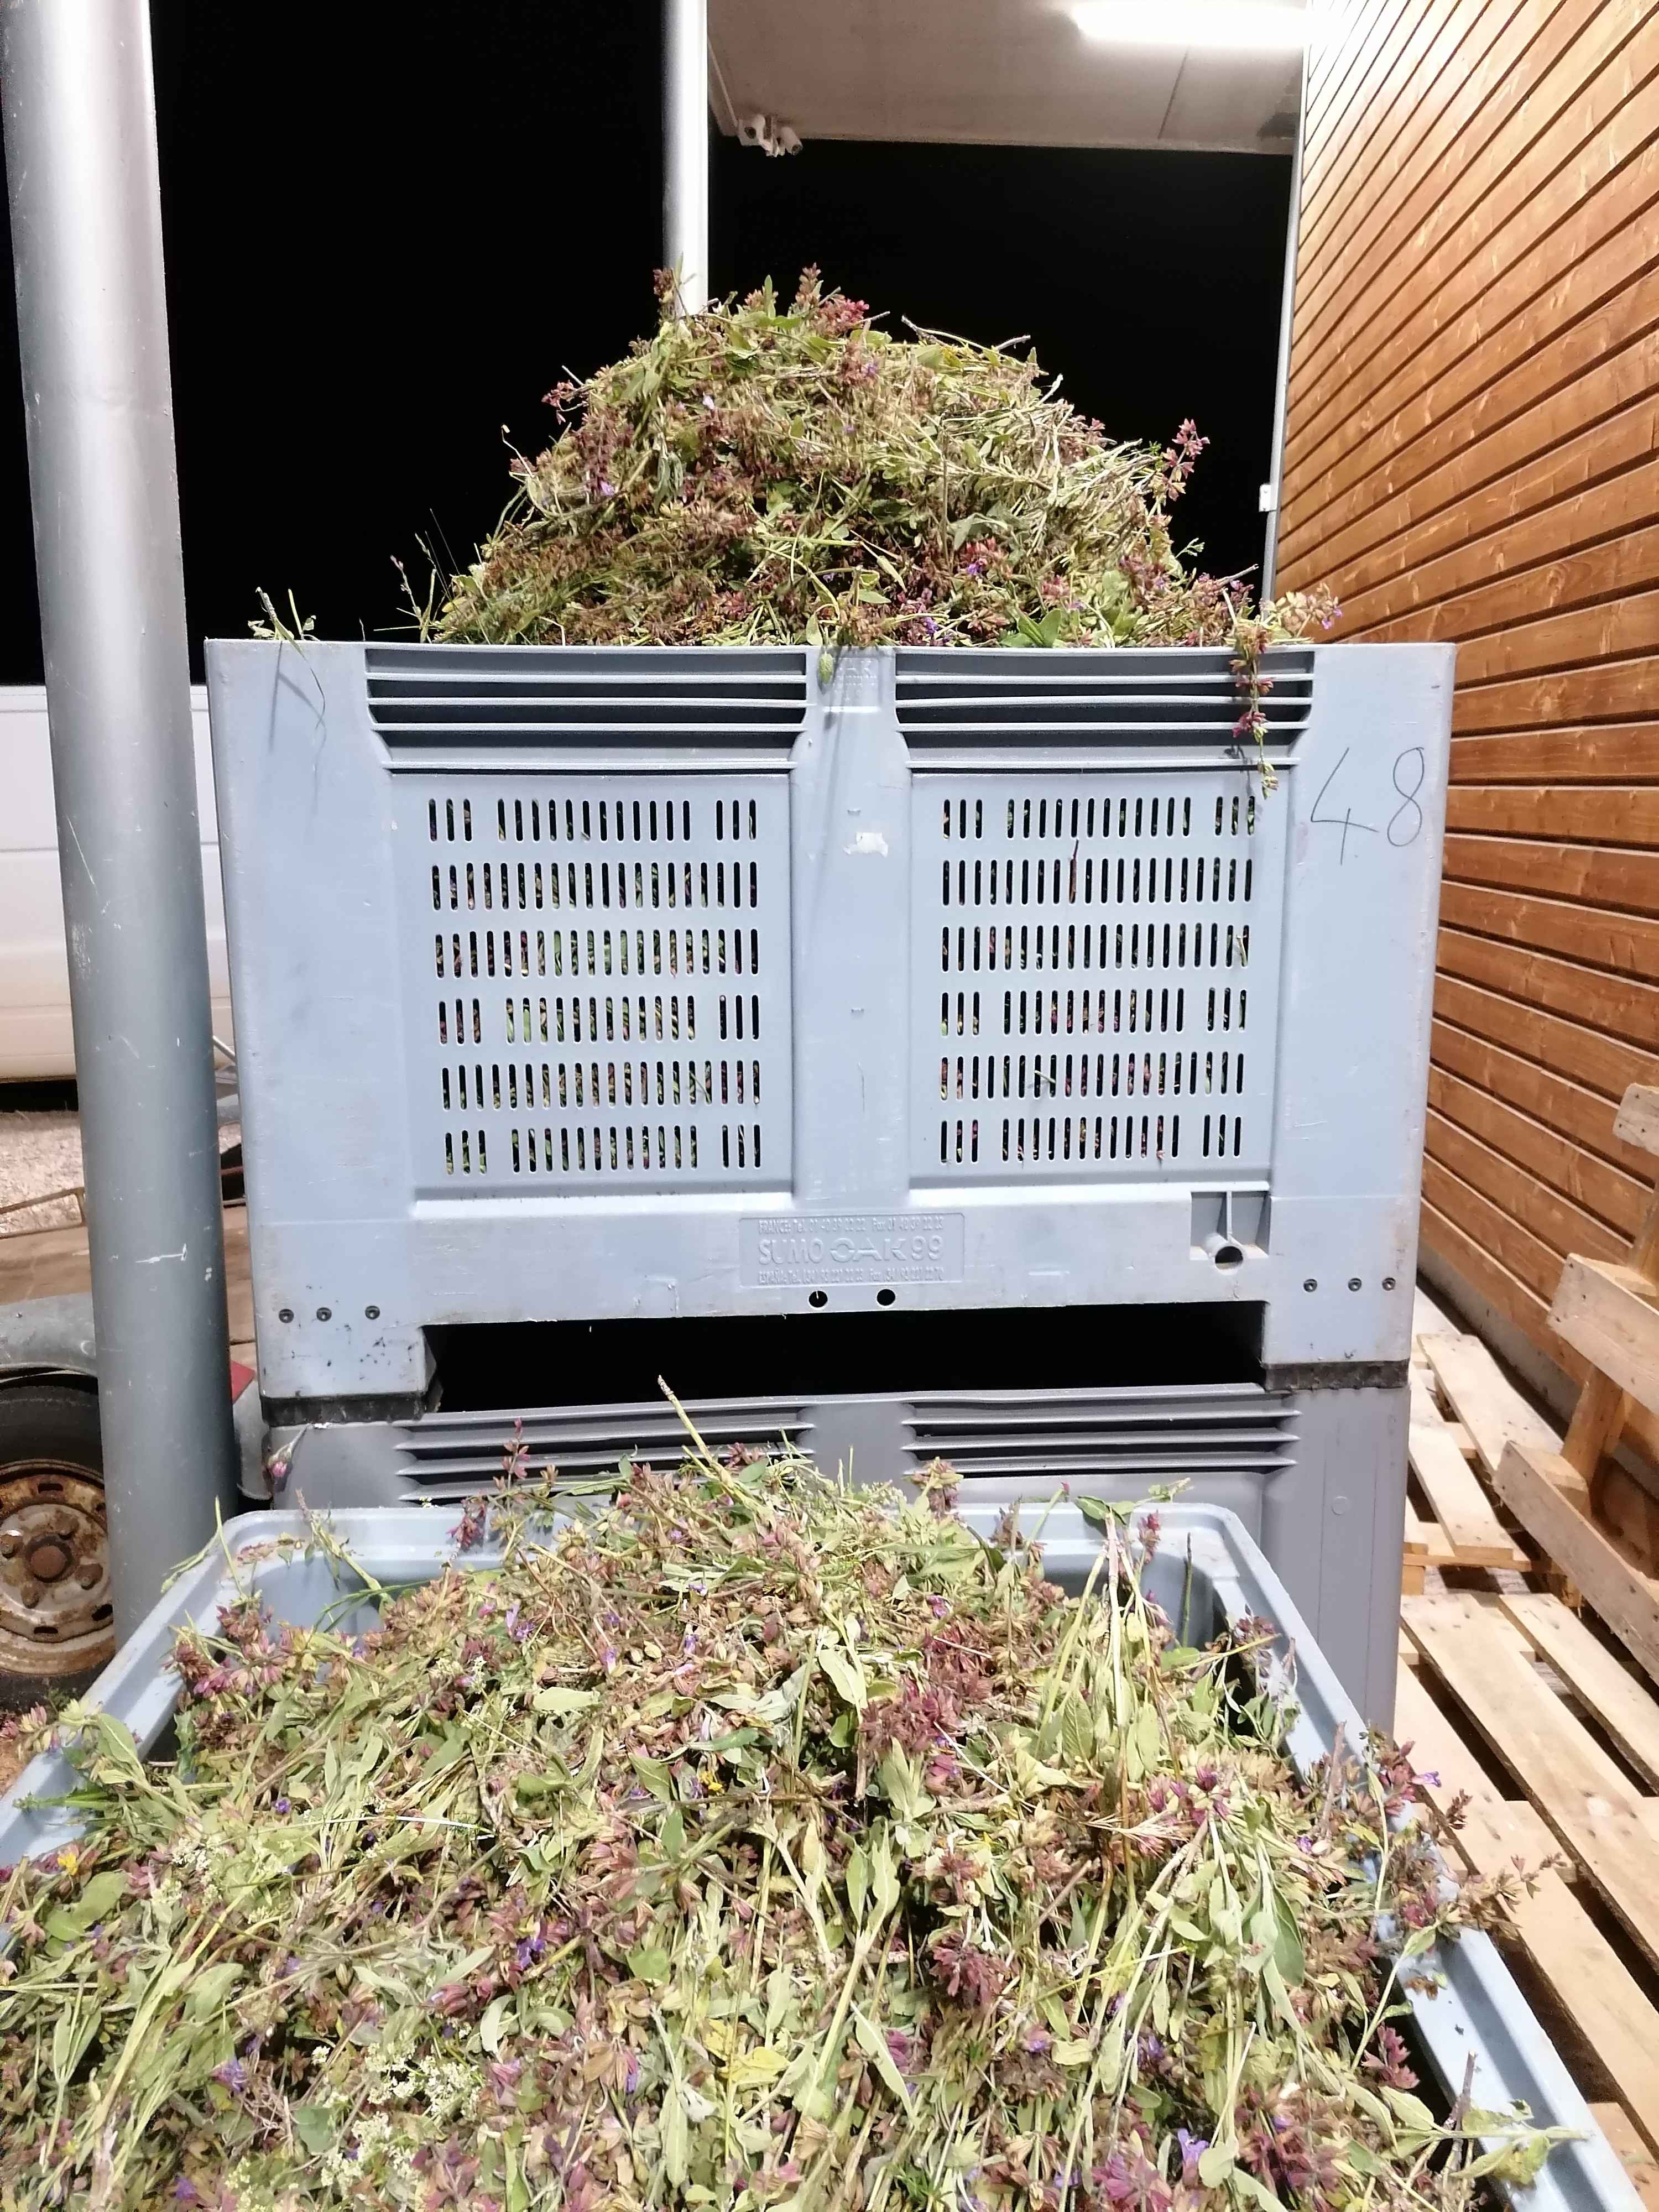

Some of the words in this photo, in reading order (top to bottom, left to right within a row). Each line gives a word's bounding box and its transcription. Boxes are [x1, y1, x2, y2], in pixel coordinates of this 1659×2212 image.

[1310, 747, 1425, 866] 48
[759, 1238, 823, 1265] SUMO
[830, 1237, 907, 1263] OAK
[912, 1235, 943, 1261] 99
